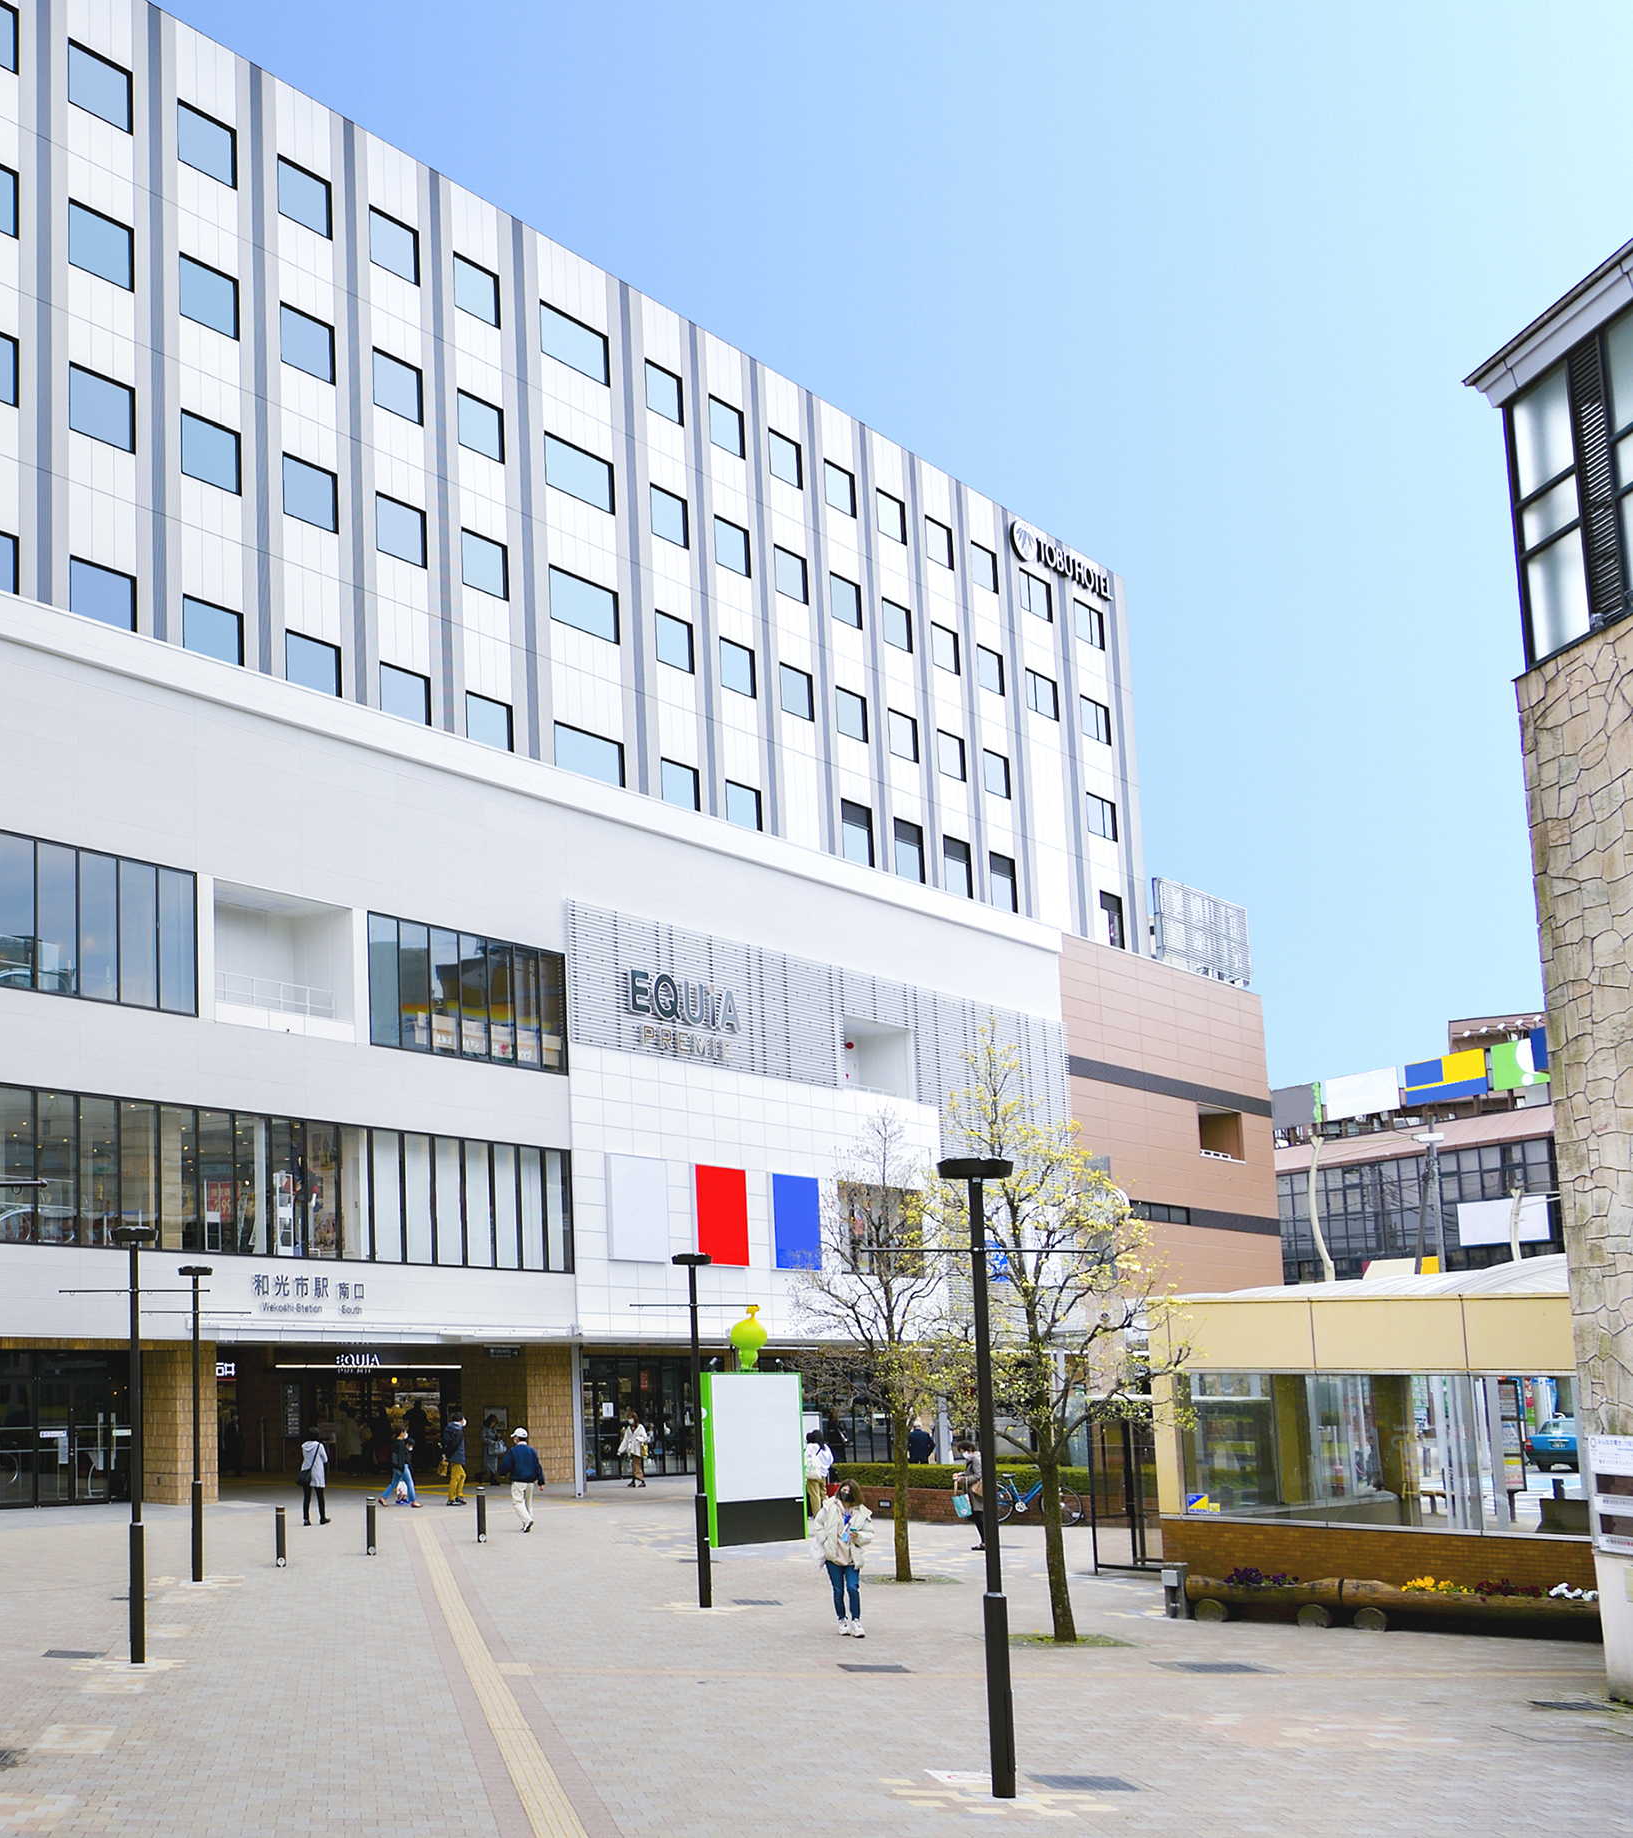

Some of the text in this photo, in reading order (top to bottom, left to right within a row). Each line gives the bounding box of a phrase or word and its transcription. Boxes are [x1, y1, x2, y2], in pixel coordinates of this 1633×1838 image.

[1036, 537, 1113, 601] TOBU HOTEL
[254, 1274, 365, 1300] 和光市駅 南口
[261, 1302, 363, 1315] Wakoshi Station South
